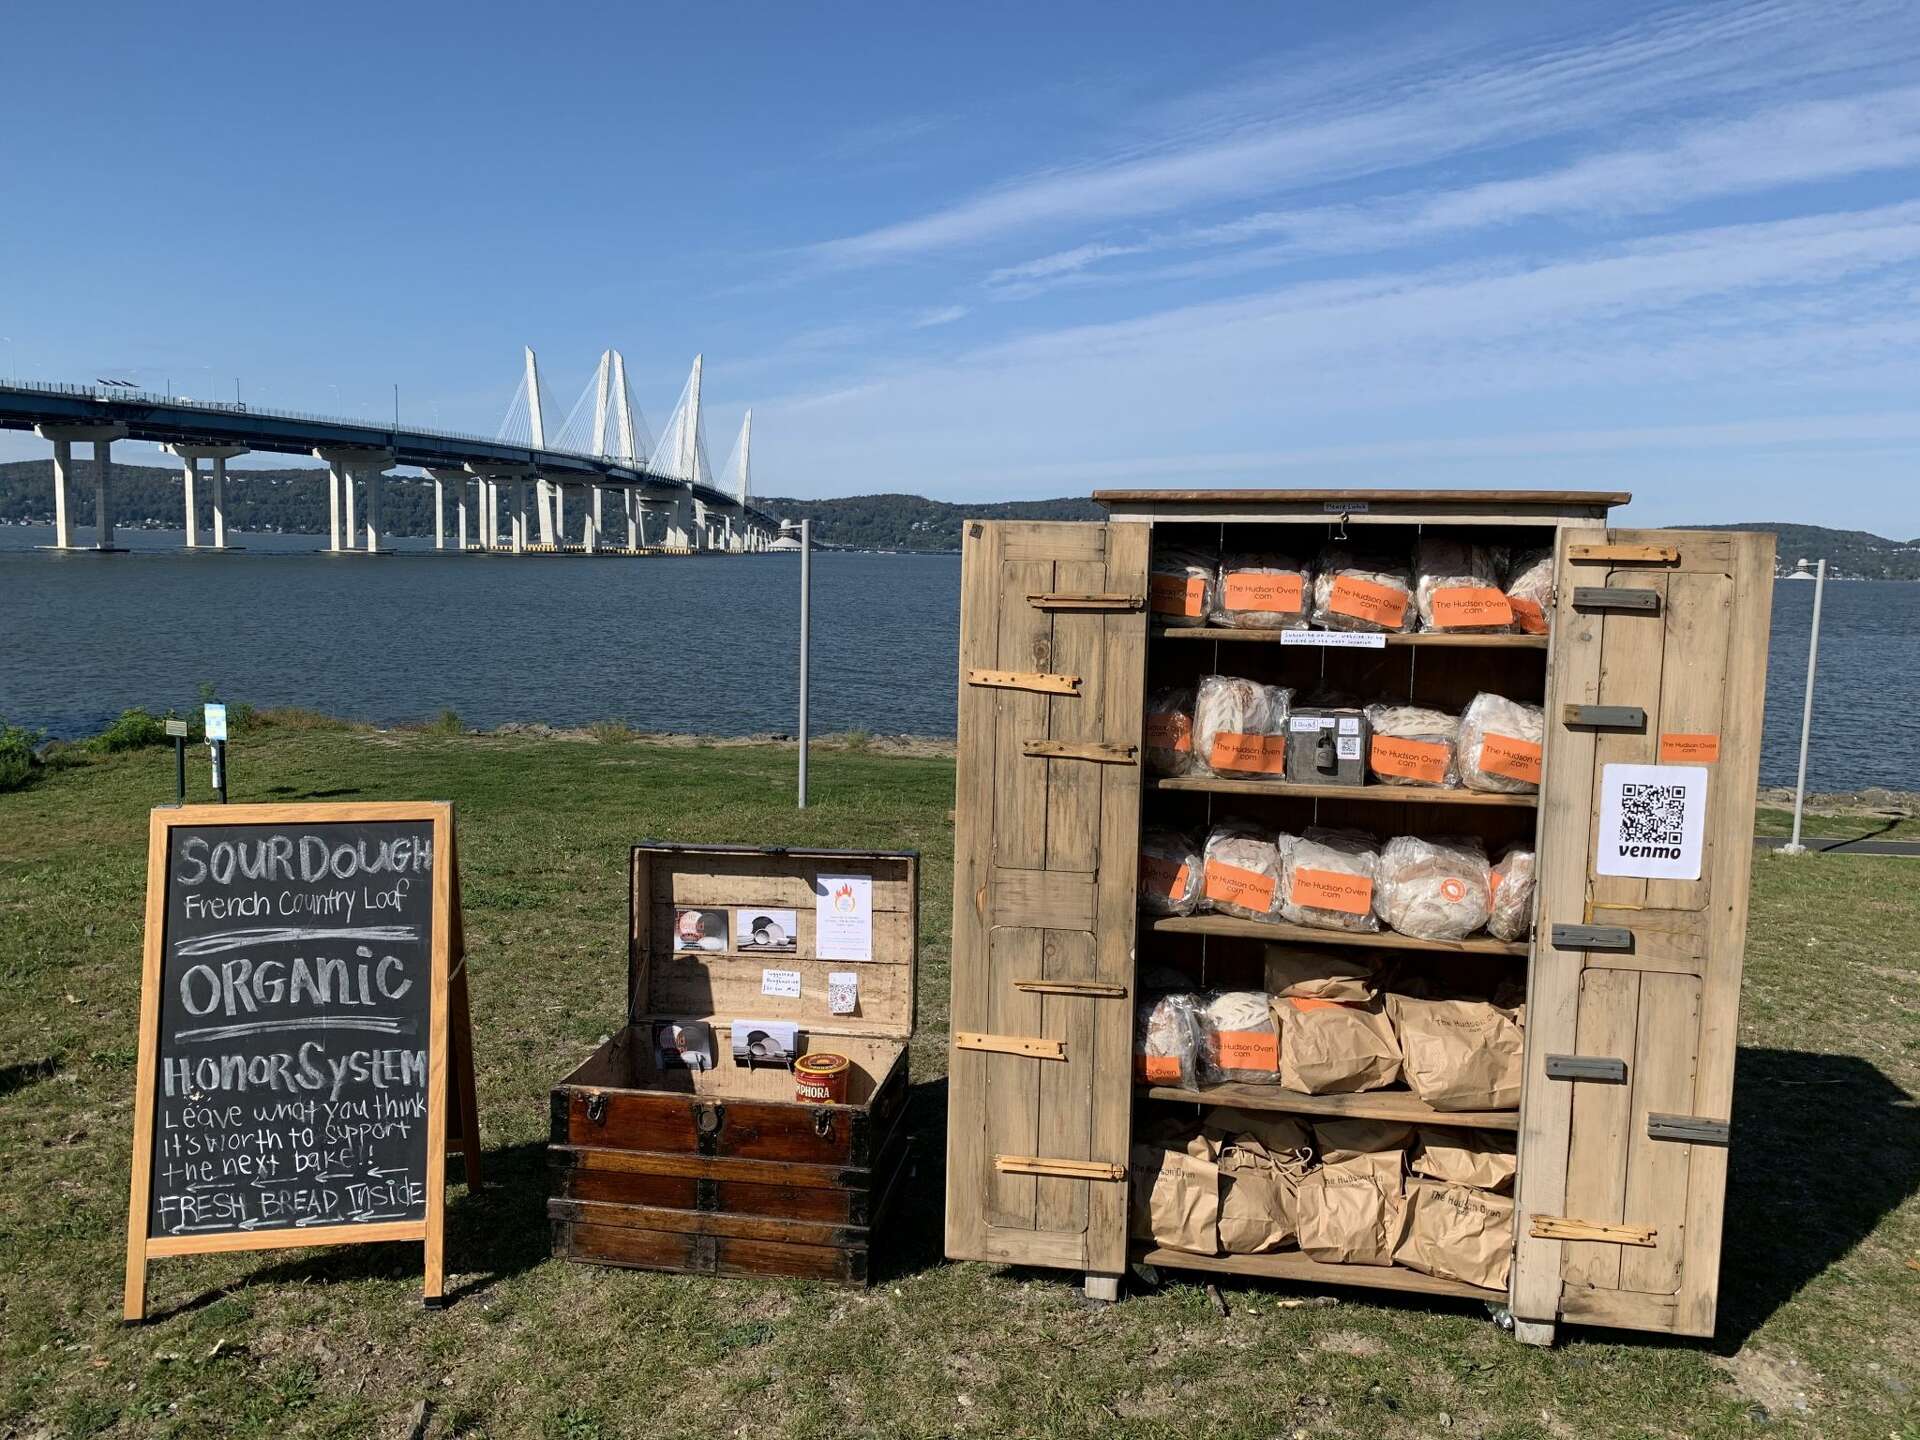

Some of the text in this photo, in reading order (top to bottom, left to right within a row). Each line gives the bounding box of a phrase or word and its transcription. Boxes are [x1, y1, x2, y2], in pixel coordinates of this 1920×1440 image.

[1245, 585, 1275, 593] Hudson
[1276, 586, 1299, 594] Oven
[1337, 587, 1402, 612] The Hudson Oven
[1436, 600, 1507, 609] The Hudson Oven
[1217, 743, 1230, 751] The
[1232, 745, 1260, 755] Hudson
[1373, 746, 1442, 765] The Hudson Oven
[1486, 745, 1501, 754] The
[1503, 750, 1533, 763] Hudson
[1618, 845, 1682, 860] venmo
[1220, 875, 1248, 889] Hudson
[1249, 883, 1270, 896] Oven
[1297, 879, 1367, 897] The Hudson Oven
[184, 877, 410, 923] French Country Loaf
[1224, 1042, 1251, 1051] Hudson
[1253, 1044, 1273, 1053] Oven
[165, 1091, 427, 1129] Leave what you think
[203, 1128, 283, 1154] worth
[288, 1127, 315, 1149] to
[325, 1120, 411, 1151] support
[161, 1161, 213, 1188] the
[222, 1153, 280, 1179] next
[157, 1193, 246, 1230] FRESH
[261, 1188, 338, 1218] BREAD
[1431, 1190, 1445, 1201] The
[1480, 1204, 1501, 1218] Oven
